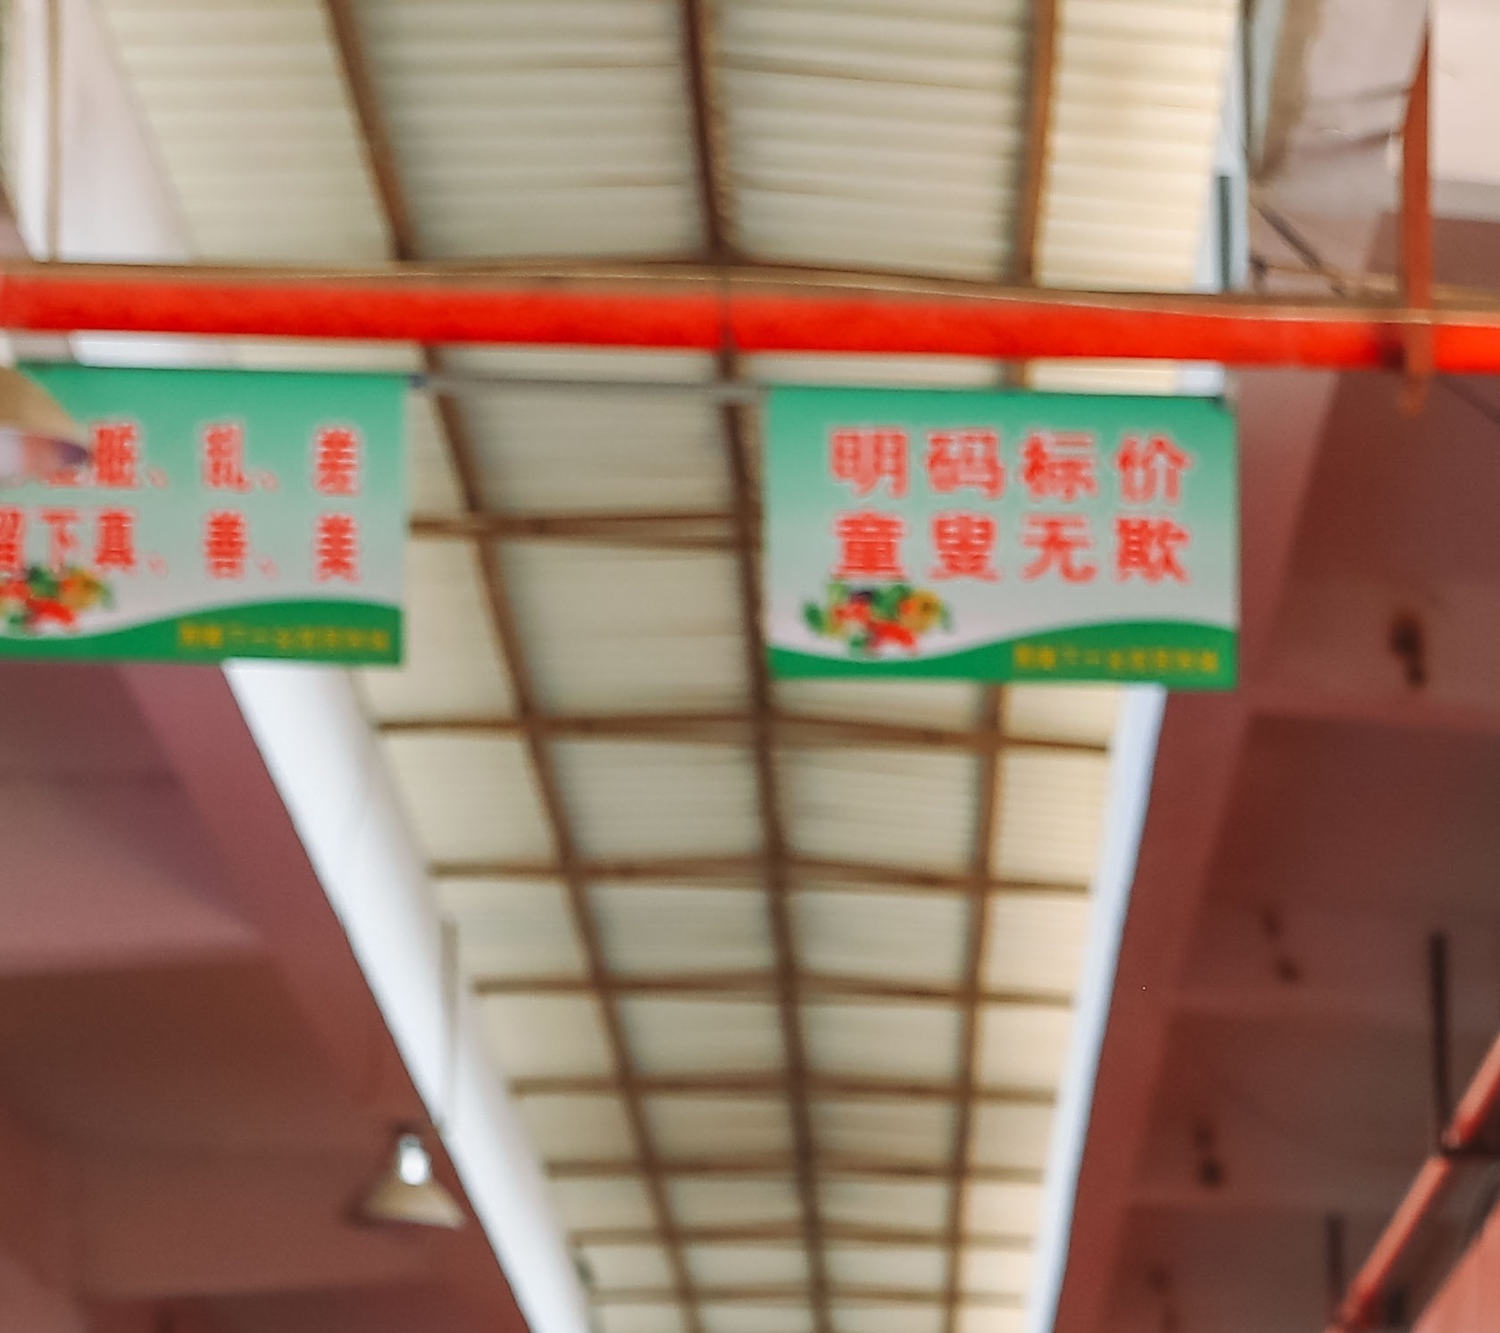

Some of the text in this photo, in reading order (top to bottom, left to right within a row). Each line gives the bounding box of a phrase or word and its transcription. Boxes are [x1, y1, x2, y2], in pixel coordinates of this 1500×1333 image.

[828, 426, 1194, 503] 明码标价
[832, 512, 1192, 584] 童叟无欺
